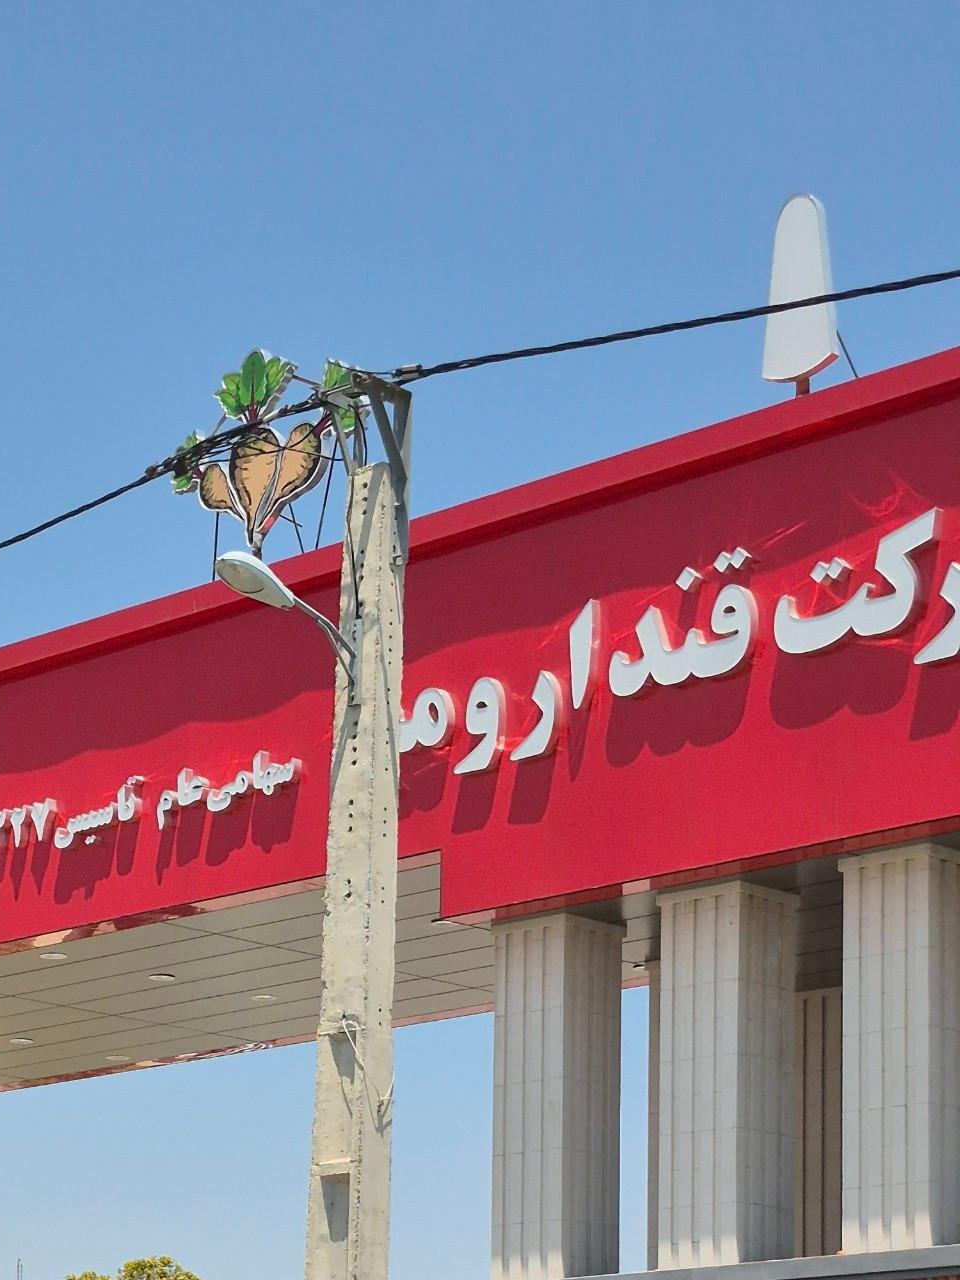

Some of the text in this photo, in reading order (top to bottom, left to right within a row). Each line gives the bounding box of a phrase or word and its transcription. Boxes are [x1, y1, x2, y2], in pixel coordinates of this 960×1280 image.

[398, 506, 960, 774] رکت قند اروم
[54, 775, 144, 849] تاسیس
[155, 767, 209, 831] عام
[207, 750, 302, 811] سهامی
